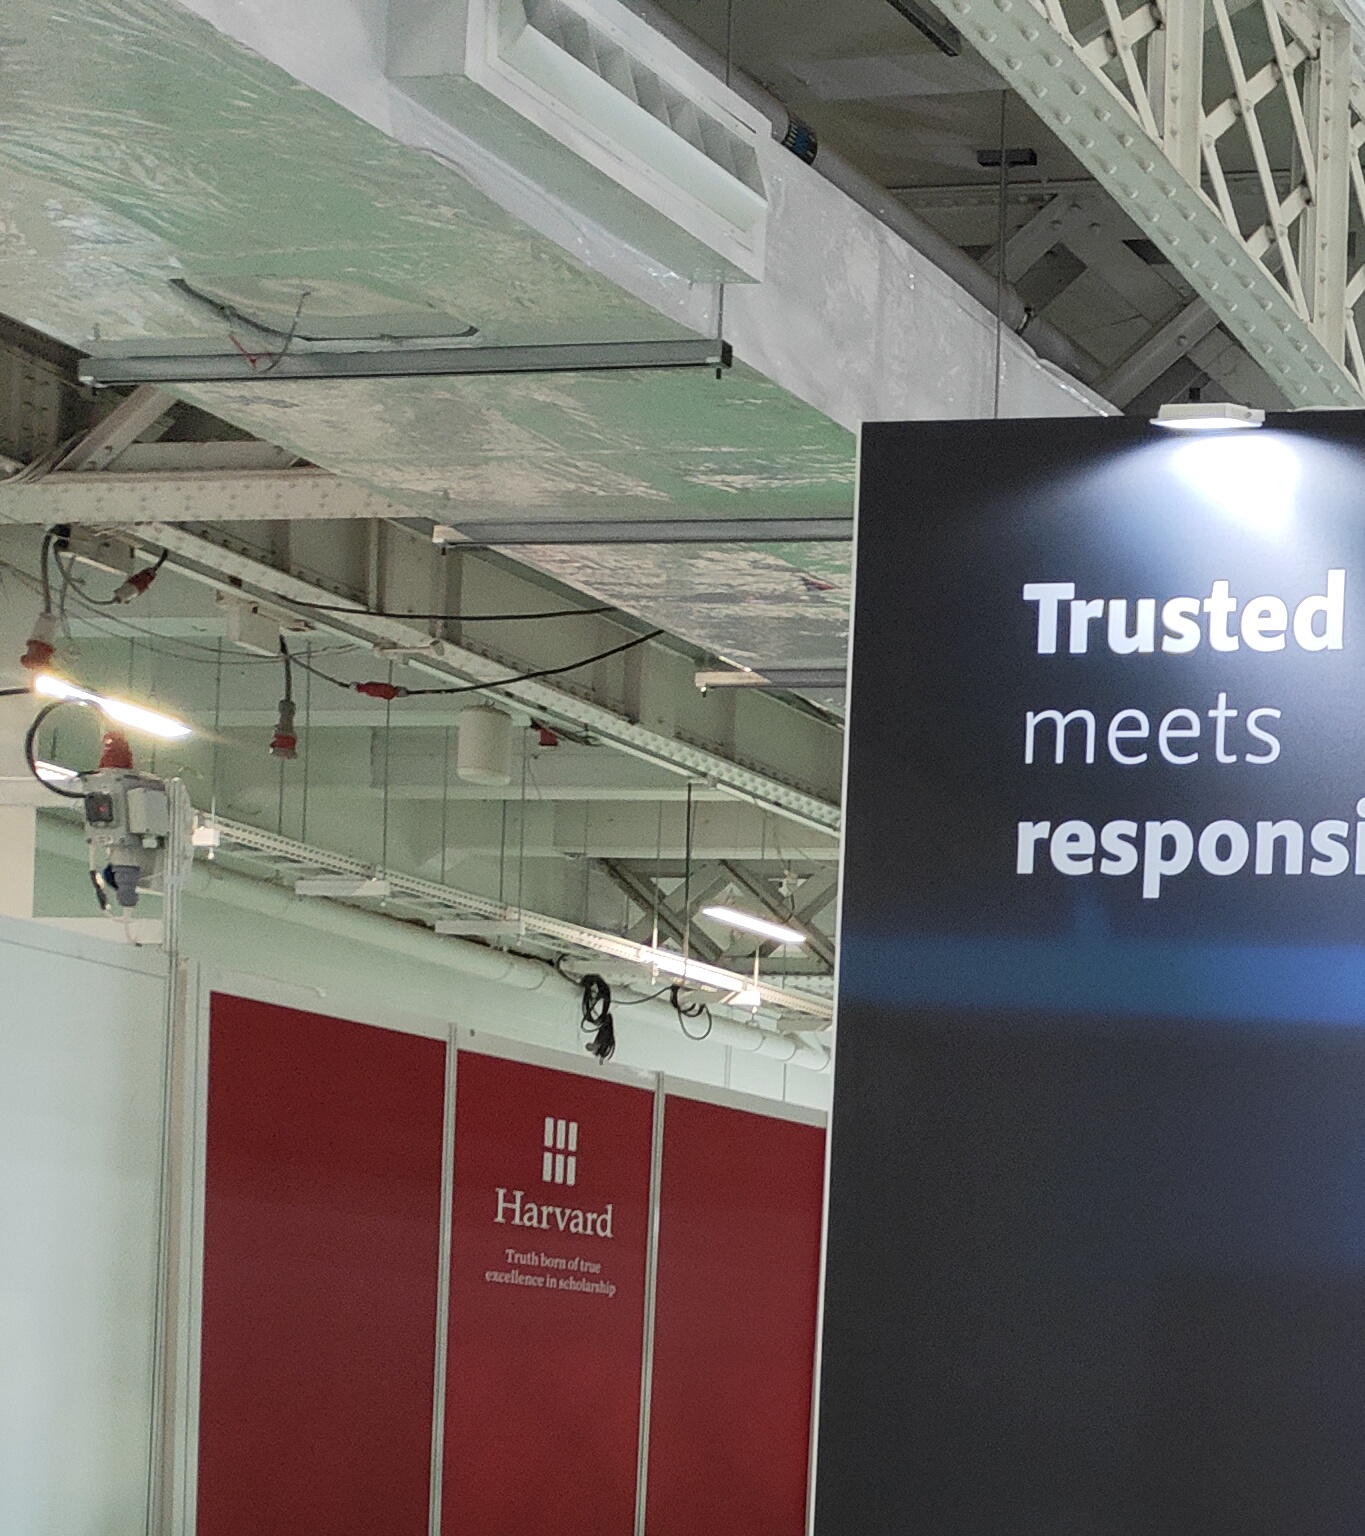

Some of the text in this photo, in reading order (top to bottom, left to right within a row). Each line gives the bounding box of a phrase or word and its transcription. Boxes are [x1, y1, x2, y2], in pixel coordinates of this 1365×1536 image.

[1023, 569, 1346, 654] Trusted
[1023, 692, 1282, 765] meets
[494, 1187, 614, 1238] Harvard
[485, 1269, 617, 1298] excellence in scholarship
[505, 1248, 601, 1274] Truth born of true
